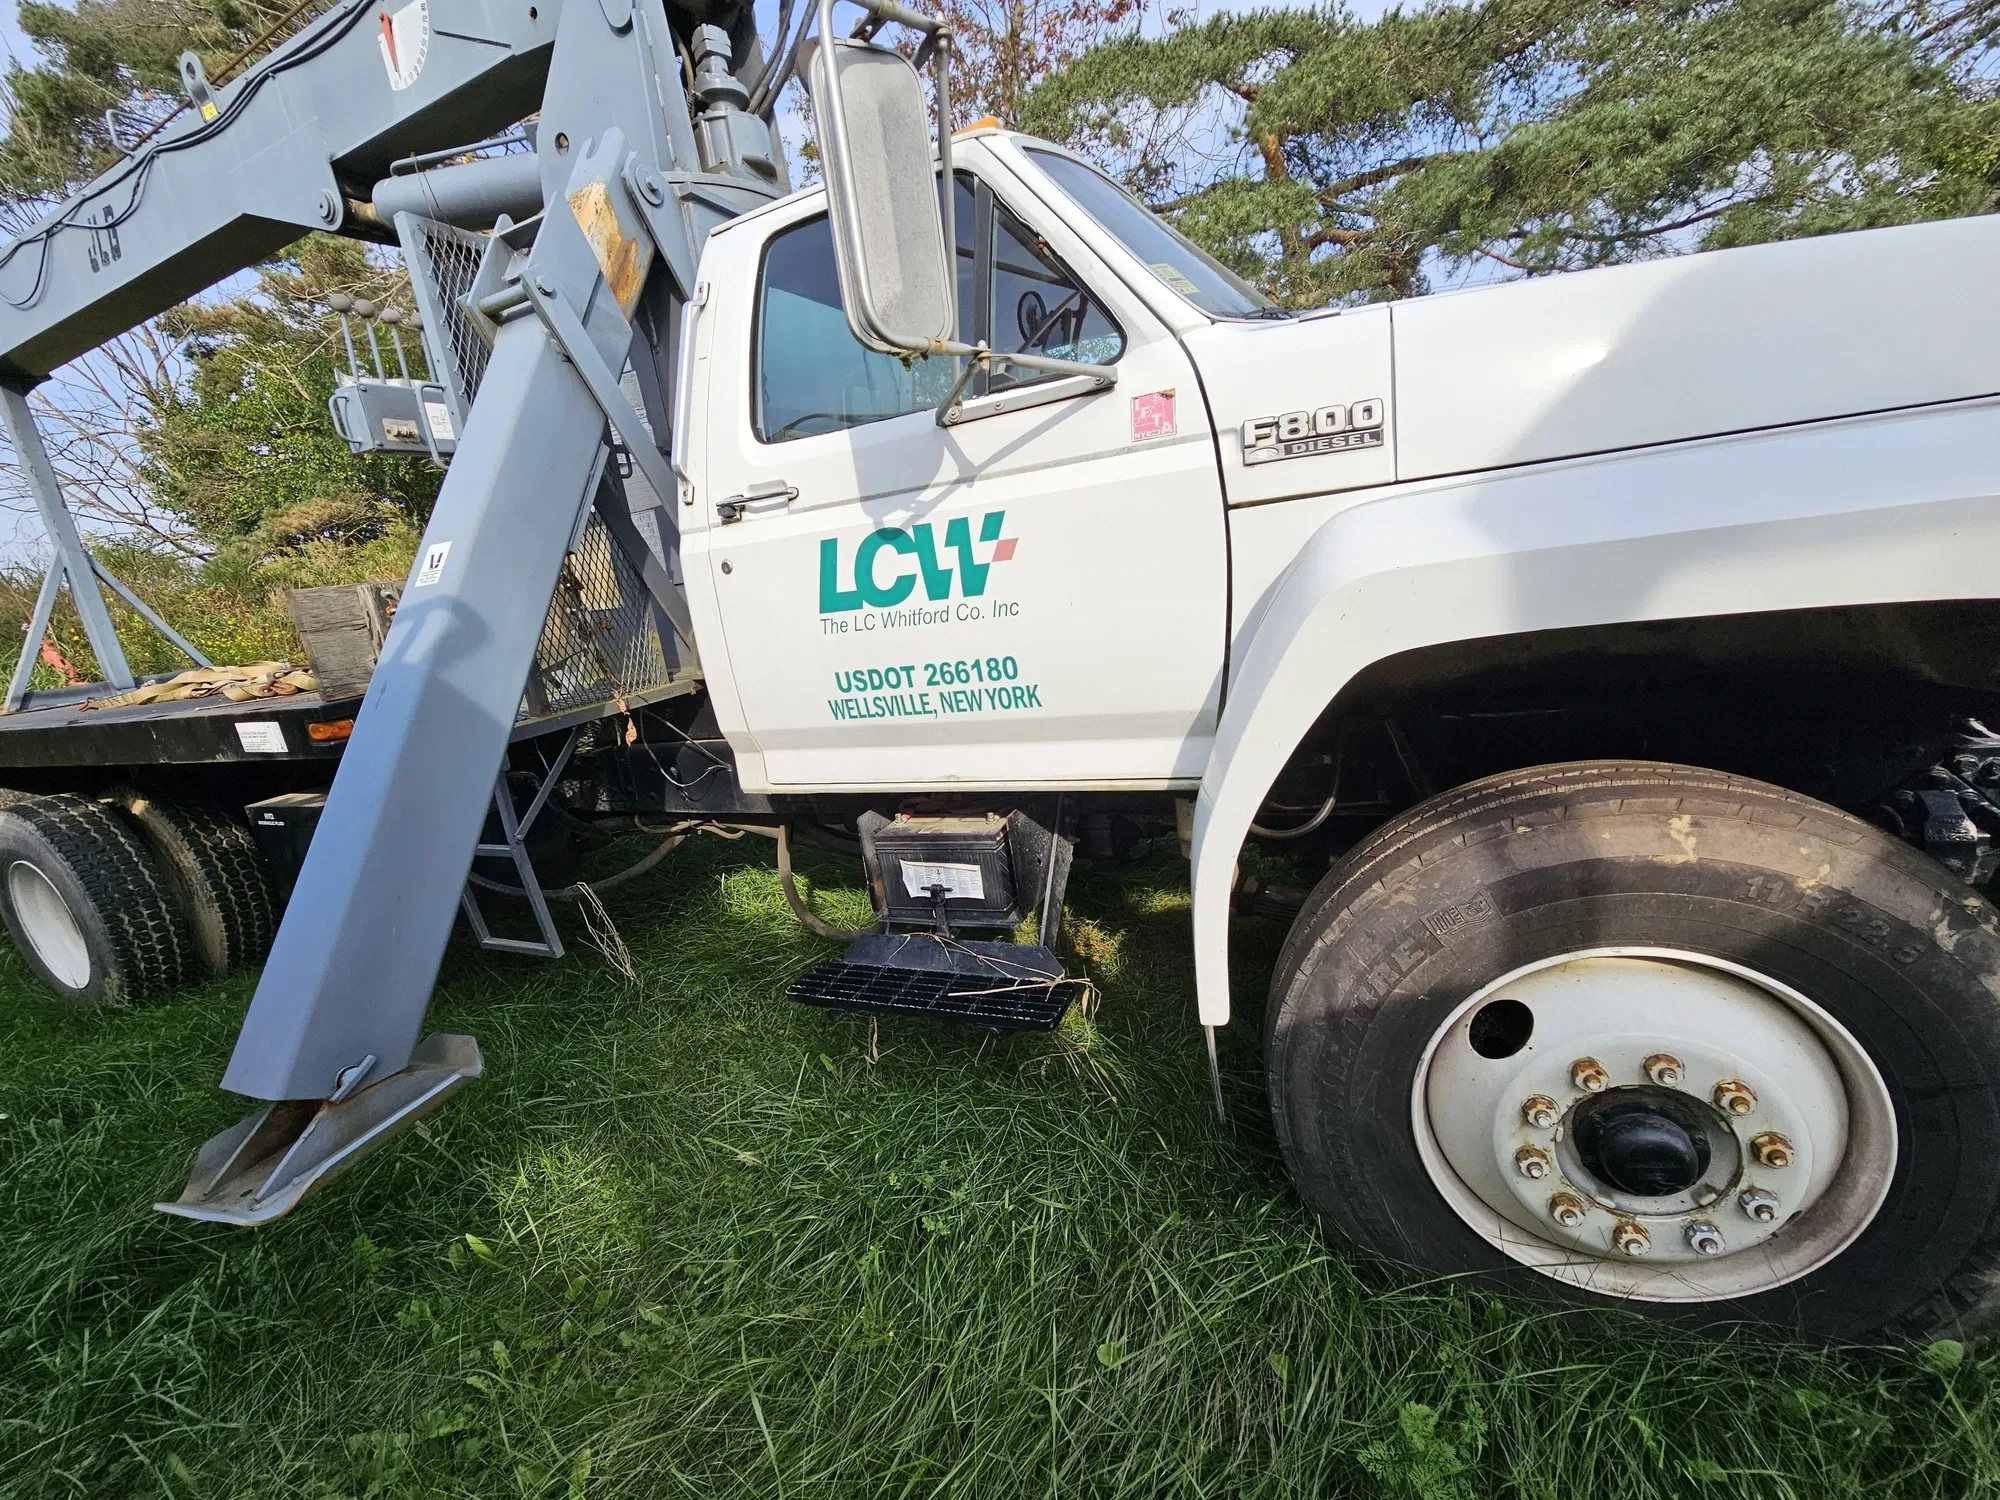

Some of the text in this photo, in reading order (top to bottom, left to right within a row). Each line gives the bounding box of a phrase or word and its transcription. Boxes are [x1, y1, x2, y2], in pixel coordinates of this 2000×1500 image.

[1242, 397, 1385, 448] F800
[1291, 433, 1377, 454] DIESEL
[819, 510, 1006, 614] LCW
[820, 599, 1020, 635] The LC Whitford Co. Inc
[834, 655, 1019, 693] USDOT 266180
[828, 684, 1043, 721] WELLSVILLE, NEW YORK
[1340, 936, 1426, 1031] TIRE
